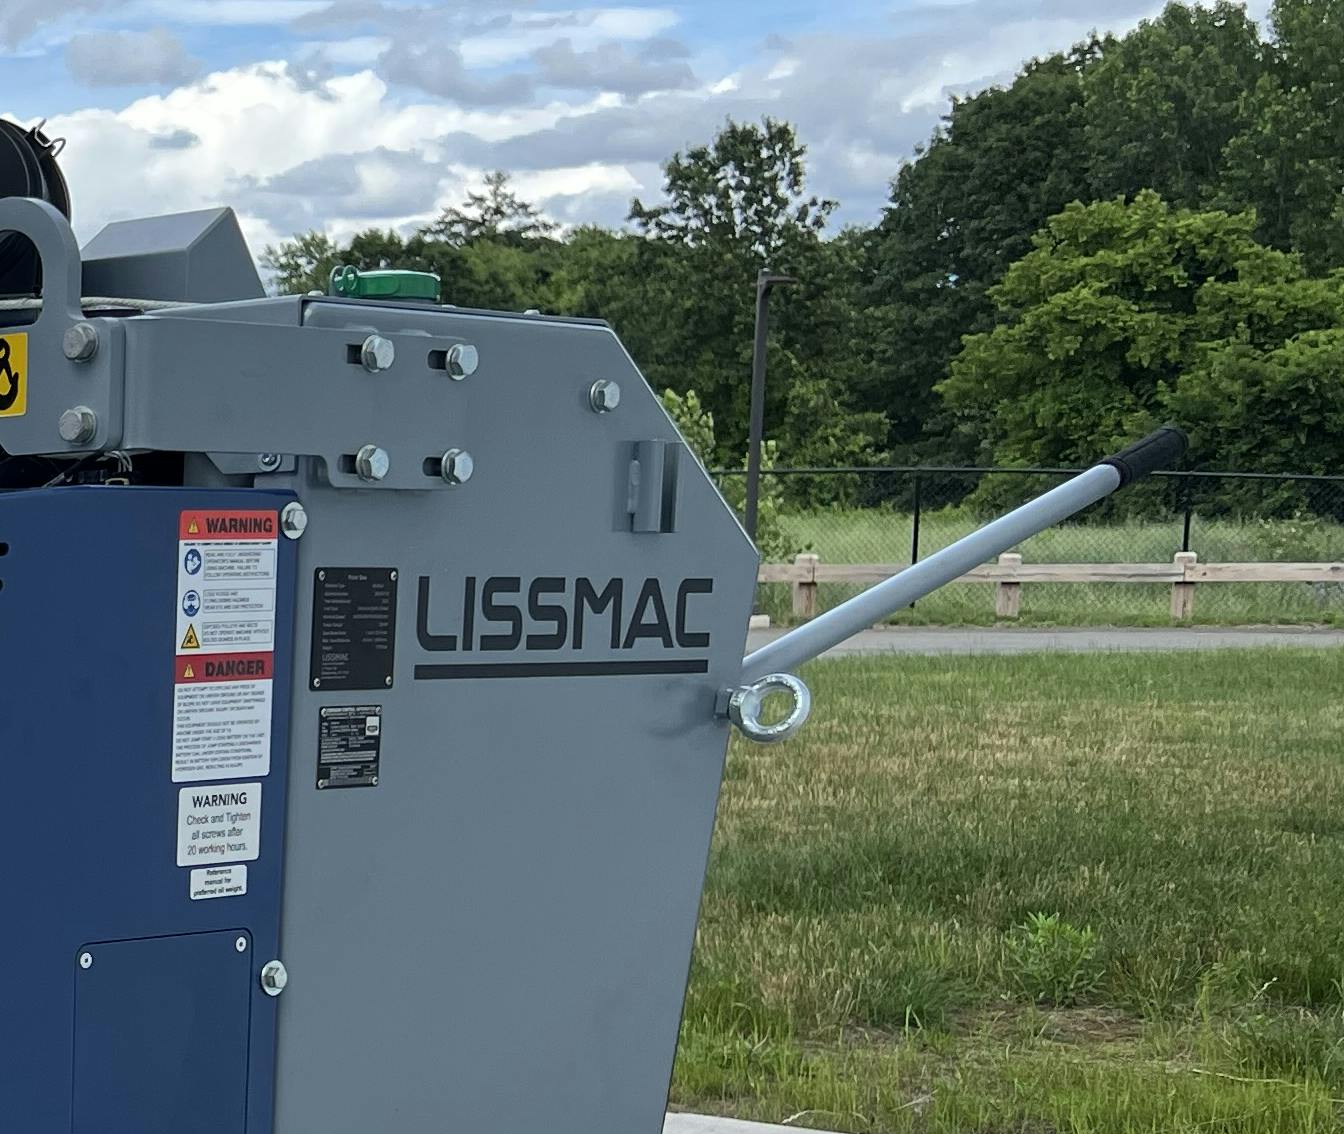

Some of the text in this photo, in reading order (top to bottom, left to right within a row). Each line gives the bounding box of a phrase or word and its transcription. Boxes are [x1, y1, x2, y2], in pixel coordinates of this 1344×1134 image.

[206, 517, 272, 534] WARNING
[416, 576, 713, 651] LISSMAC
[205, 660, 265, 677] DANGER
[192, 792, 247, 808] WARNING
[186, 812, 251, 825] Check and Tighten
[192, 827, 243, 840] all screws after
[187, 844, 197, 856] 20
[198, 844, 225, 855] working
